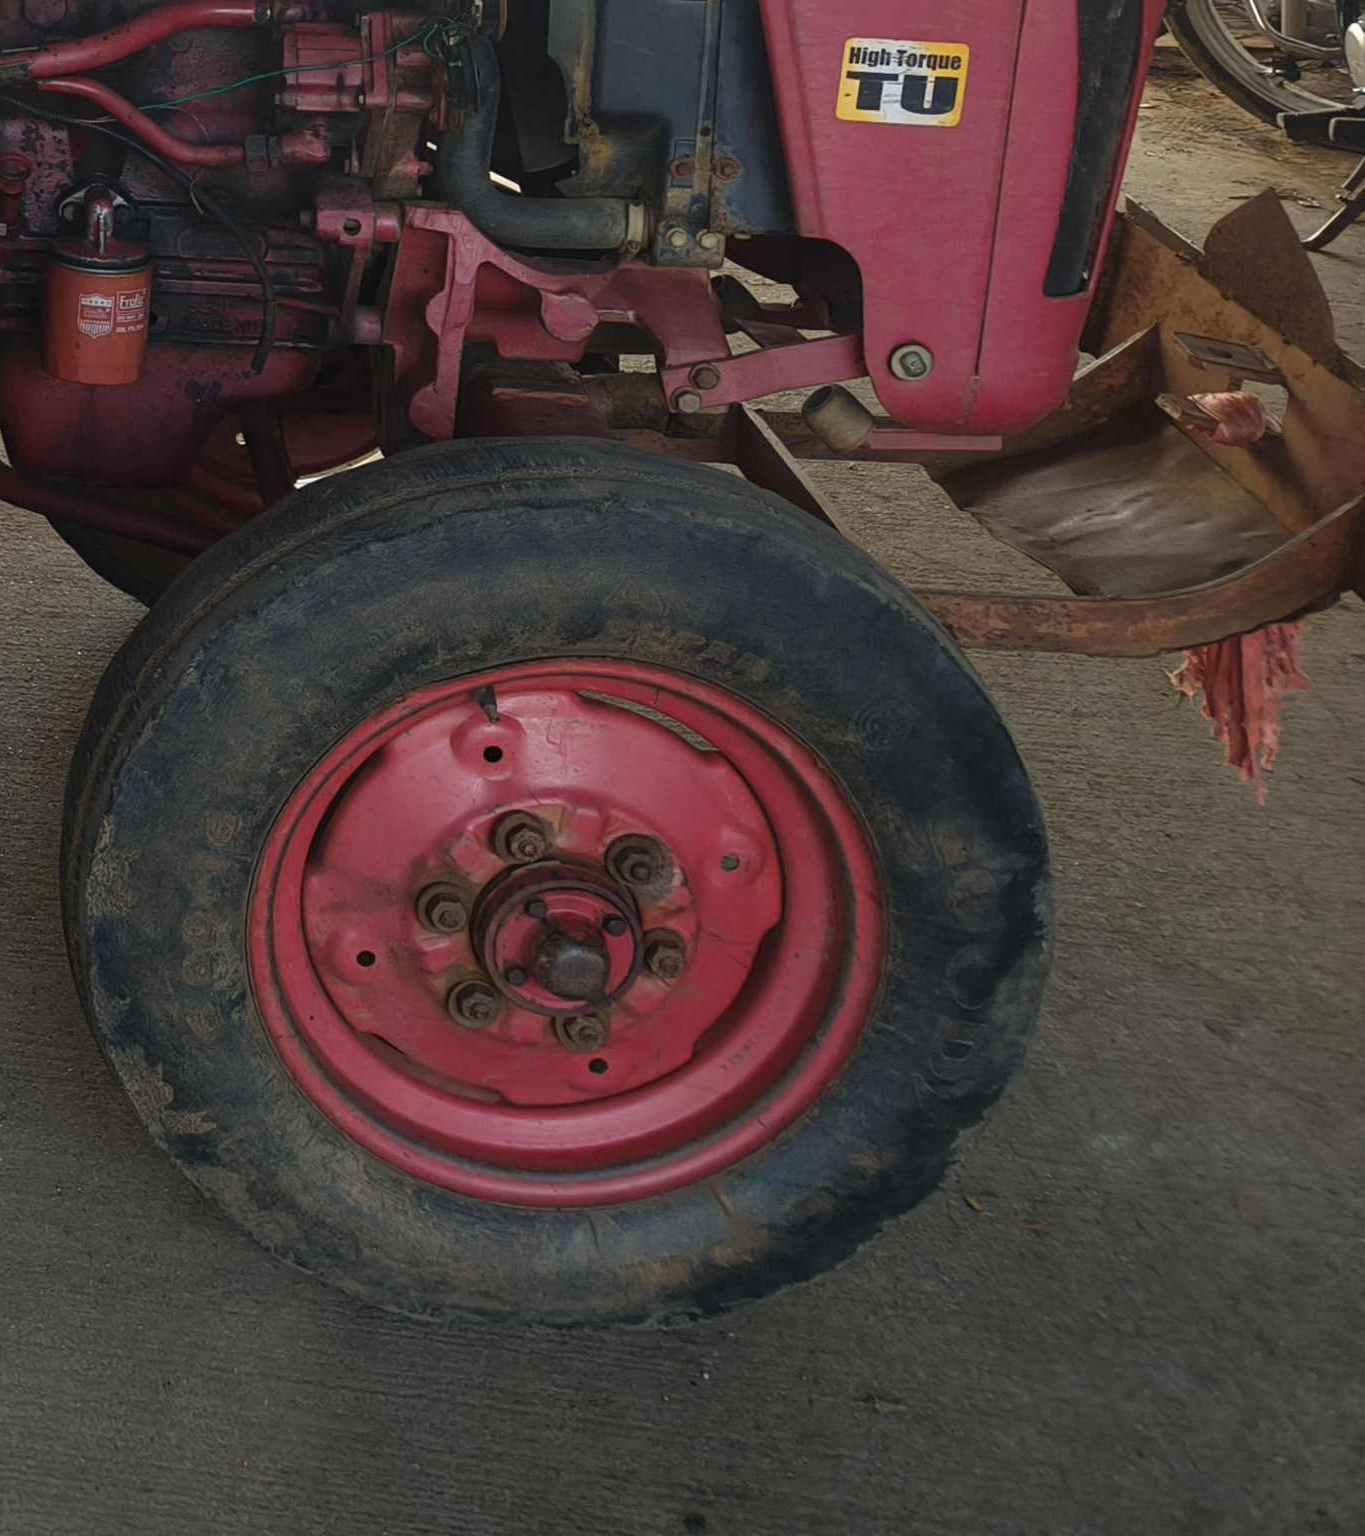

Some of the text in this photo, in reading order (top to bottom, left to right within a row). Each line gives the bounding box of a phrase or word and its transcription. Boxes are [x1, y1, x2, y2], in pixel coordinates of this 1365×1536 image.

[849, 47, 962, 71] High Torque
[846, 71, 959, 115] TU
